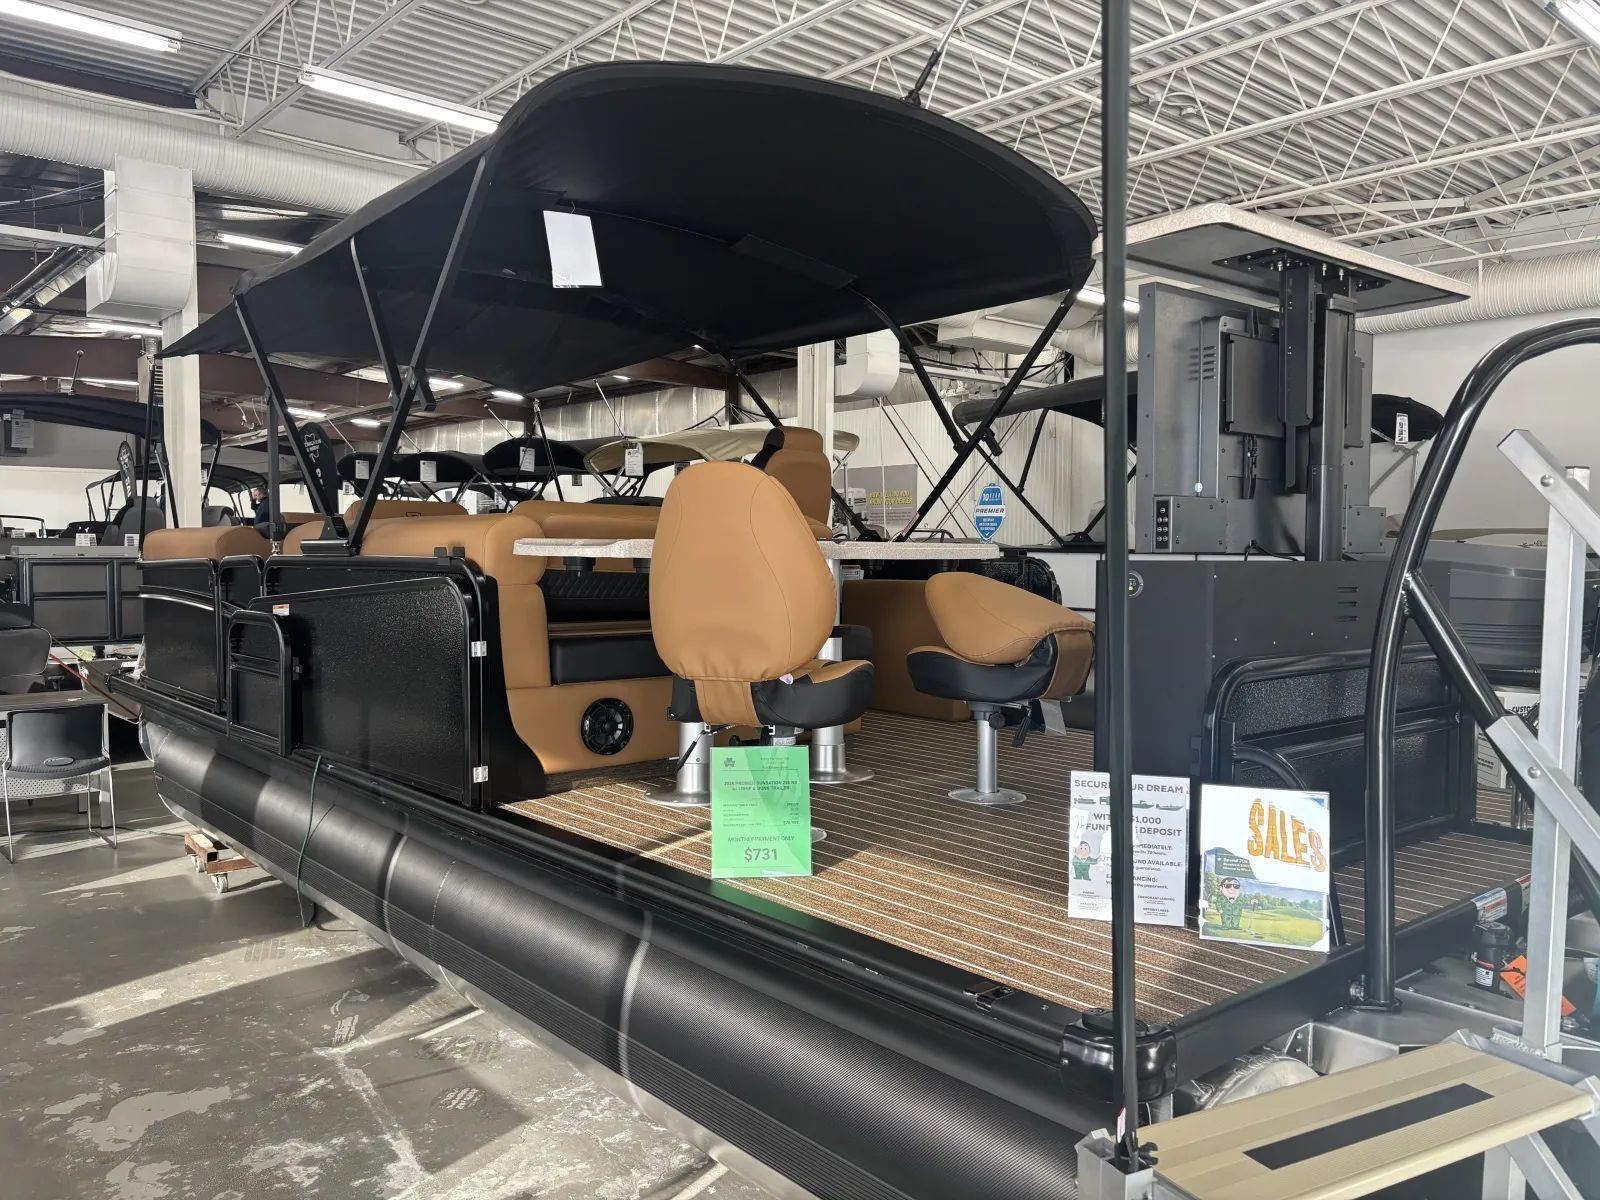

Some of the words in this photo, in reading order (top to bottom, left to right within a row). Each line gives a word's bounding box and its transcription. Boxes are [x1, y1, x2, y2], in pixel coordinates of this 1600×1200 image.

[1075, 780, 1111, 789] SECUR
[1146, 784, 1183, 793] DREAM
[1140, 827, 1182, 837] DEPOSIT
[1247, 798, 1327, 872] SALES
[744, 847, 778, 862] $731
